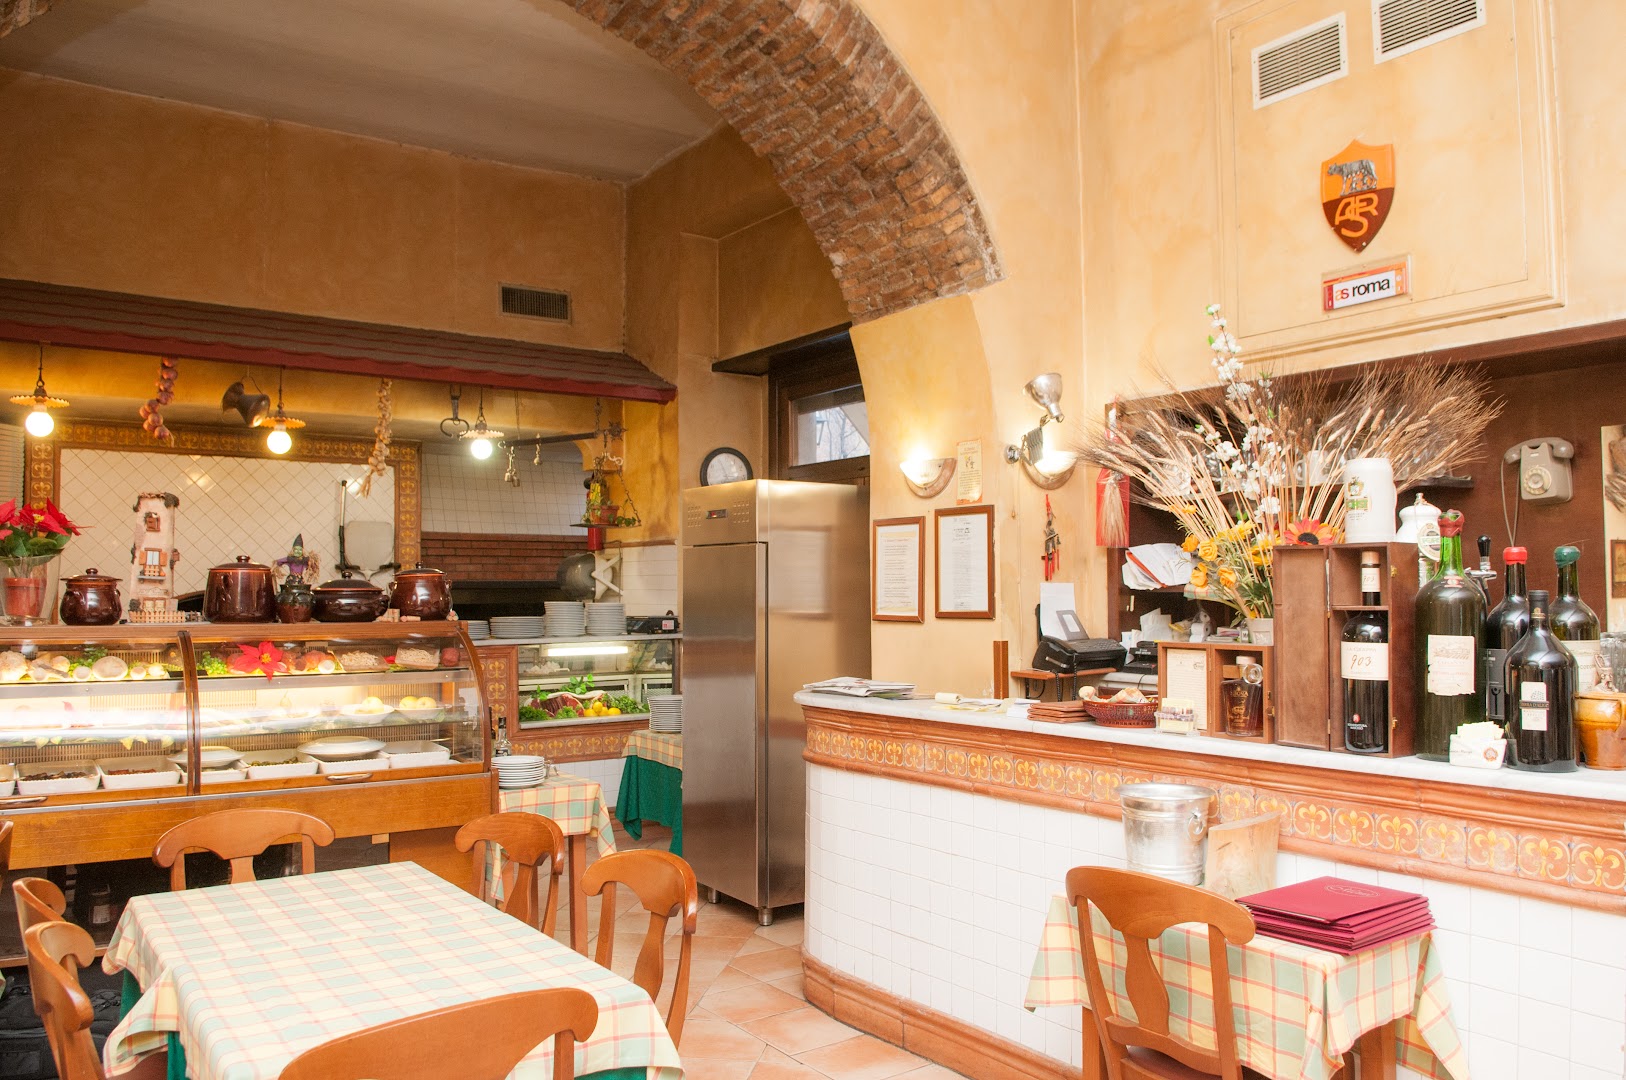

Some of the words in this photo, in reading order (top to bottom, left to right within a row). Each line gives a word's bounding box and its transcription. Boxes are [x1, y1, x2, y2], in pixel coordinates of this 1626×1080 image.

[1335, 288, 1350, 301] as
[1352, 278, 1390, 297] roma
[1350, 654, 1372, 670] 903
